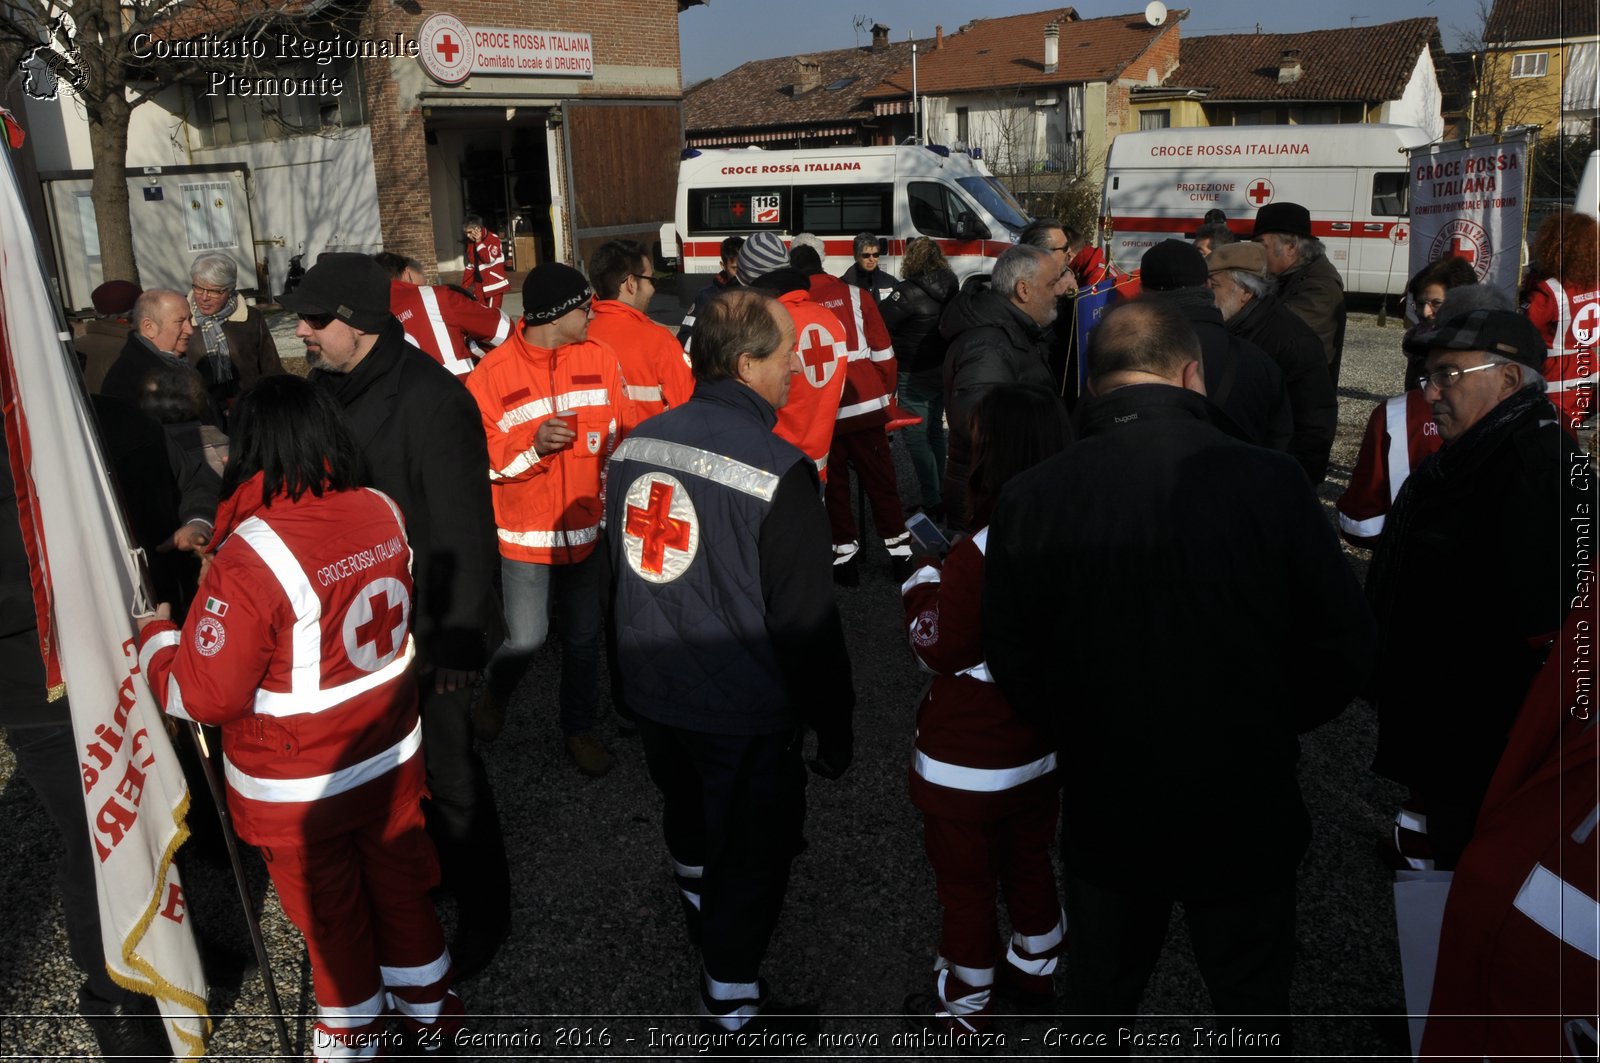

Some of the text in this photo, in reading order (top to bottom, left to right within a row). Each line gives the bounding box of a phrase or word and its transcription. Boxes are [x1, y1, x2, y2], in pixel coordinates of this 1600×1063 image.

[475, 32, 590, 52] CROCE ROSSA ITALIANA
[478, 54, 591, 71] Comitato Locale di DRUENTO
[1151, 143, 1310, 157] CROCE ROSSA ITALIANA
[721, 162, 861, 175] CROCE ROSSA ITALIANA
[1416, 154, 1517, 181] CROCE ROSSA
[1176, 183, 1236, 192] PROTEZIONE
[1433, 176, 1496, 198] ITALIANA
[756, 196, 779, 207] 118
[1190, 193, 1220, 202] CIVILE
[1122, 240, 1153, 248] OFFICINA
[536, 294, 582, 319] CALVIN
[317, 536, 404, 587] CROCE ROSSA ITALIANA
